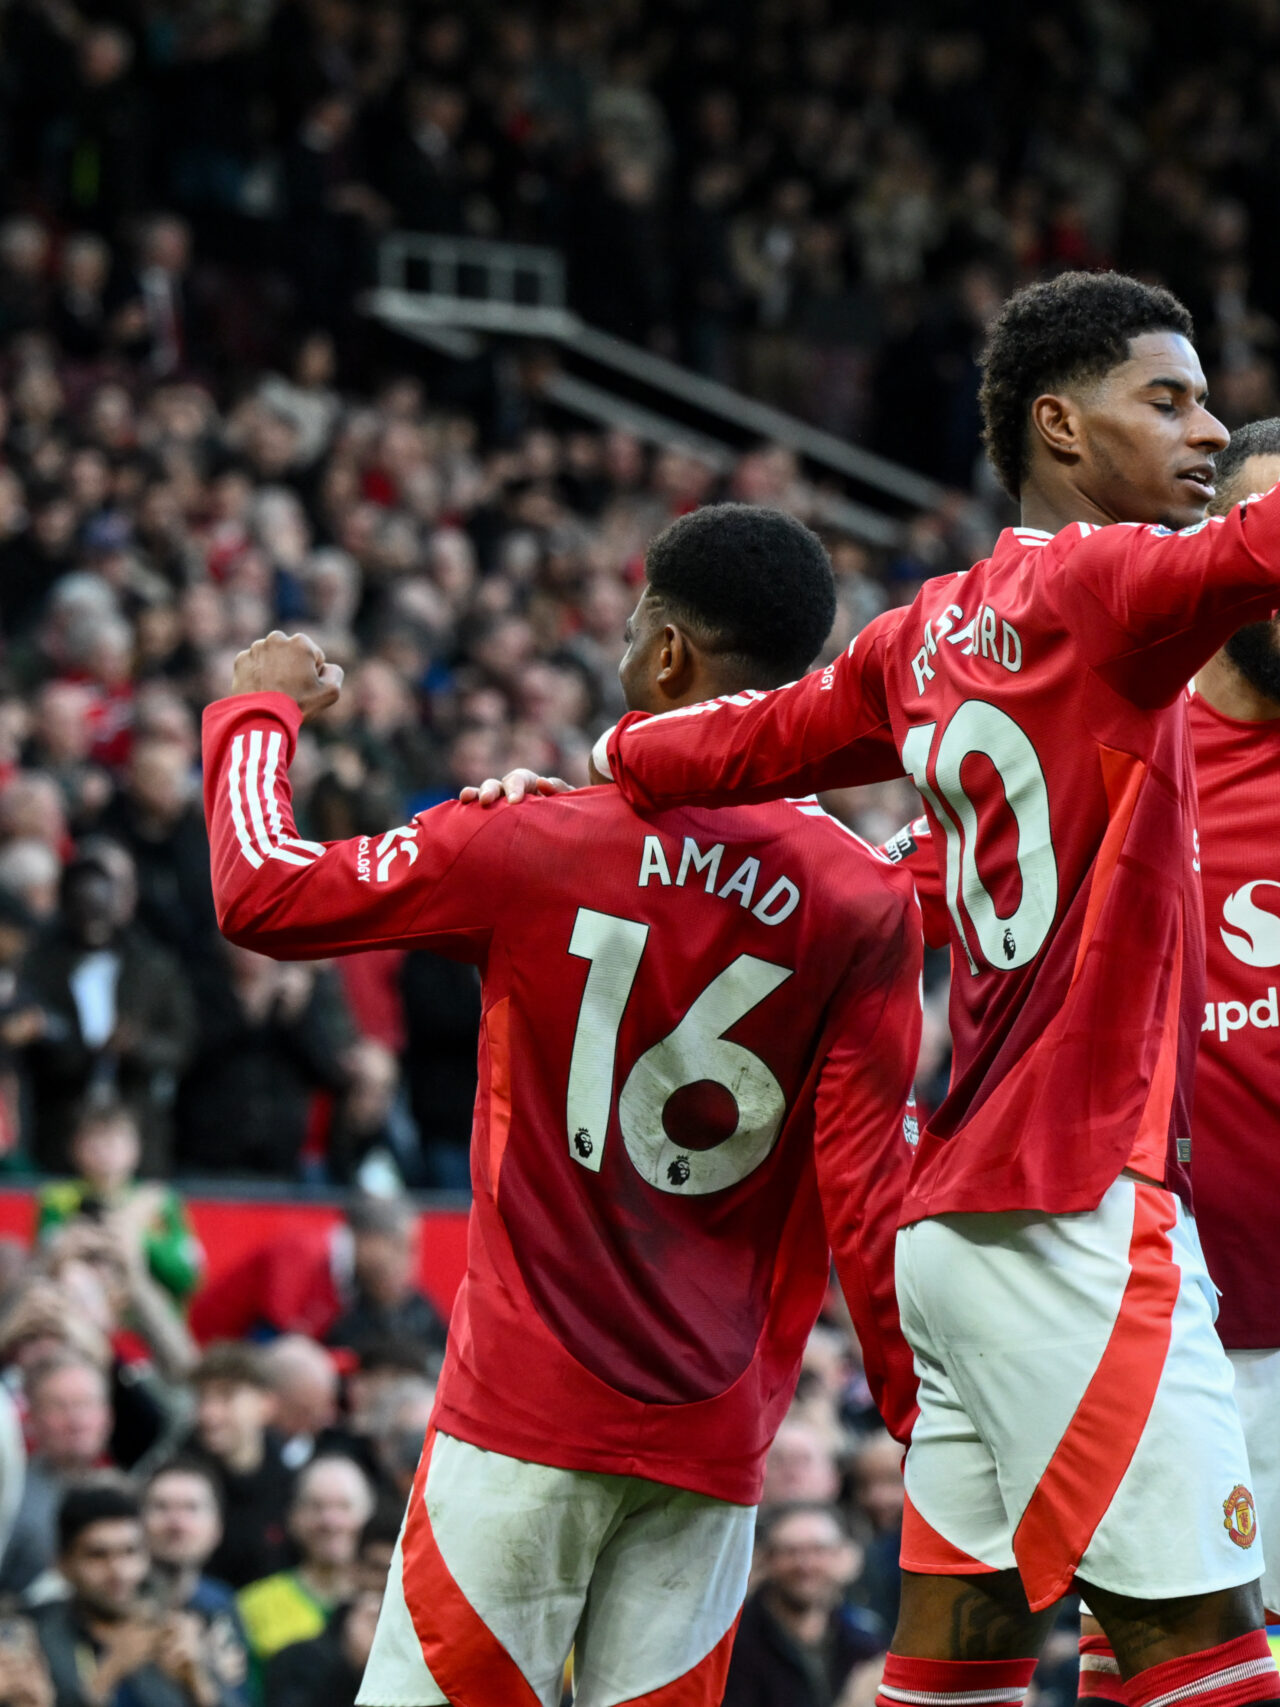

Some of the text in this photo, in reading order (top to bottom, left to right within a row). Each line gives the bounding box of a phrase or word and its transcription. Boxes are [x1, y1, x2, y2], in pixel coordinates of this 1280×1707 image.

[637, 835, 800, 926] AMAD
[902, 698, 1058, 977] 10
[566, 906, 796, 1196] 16
